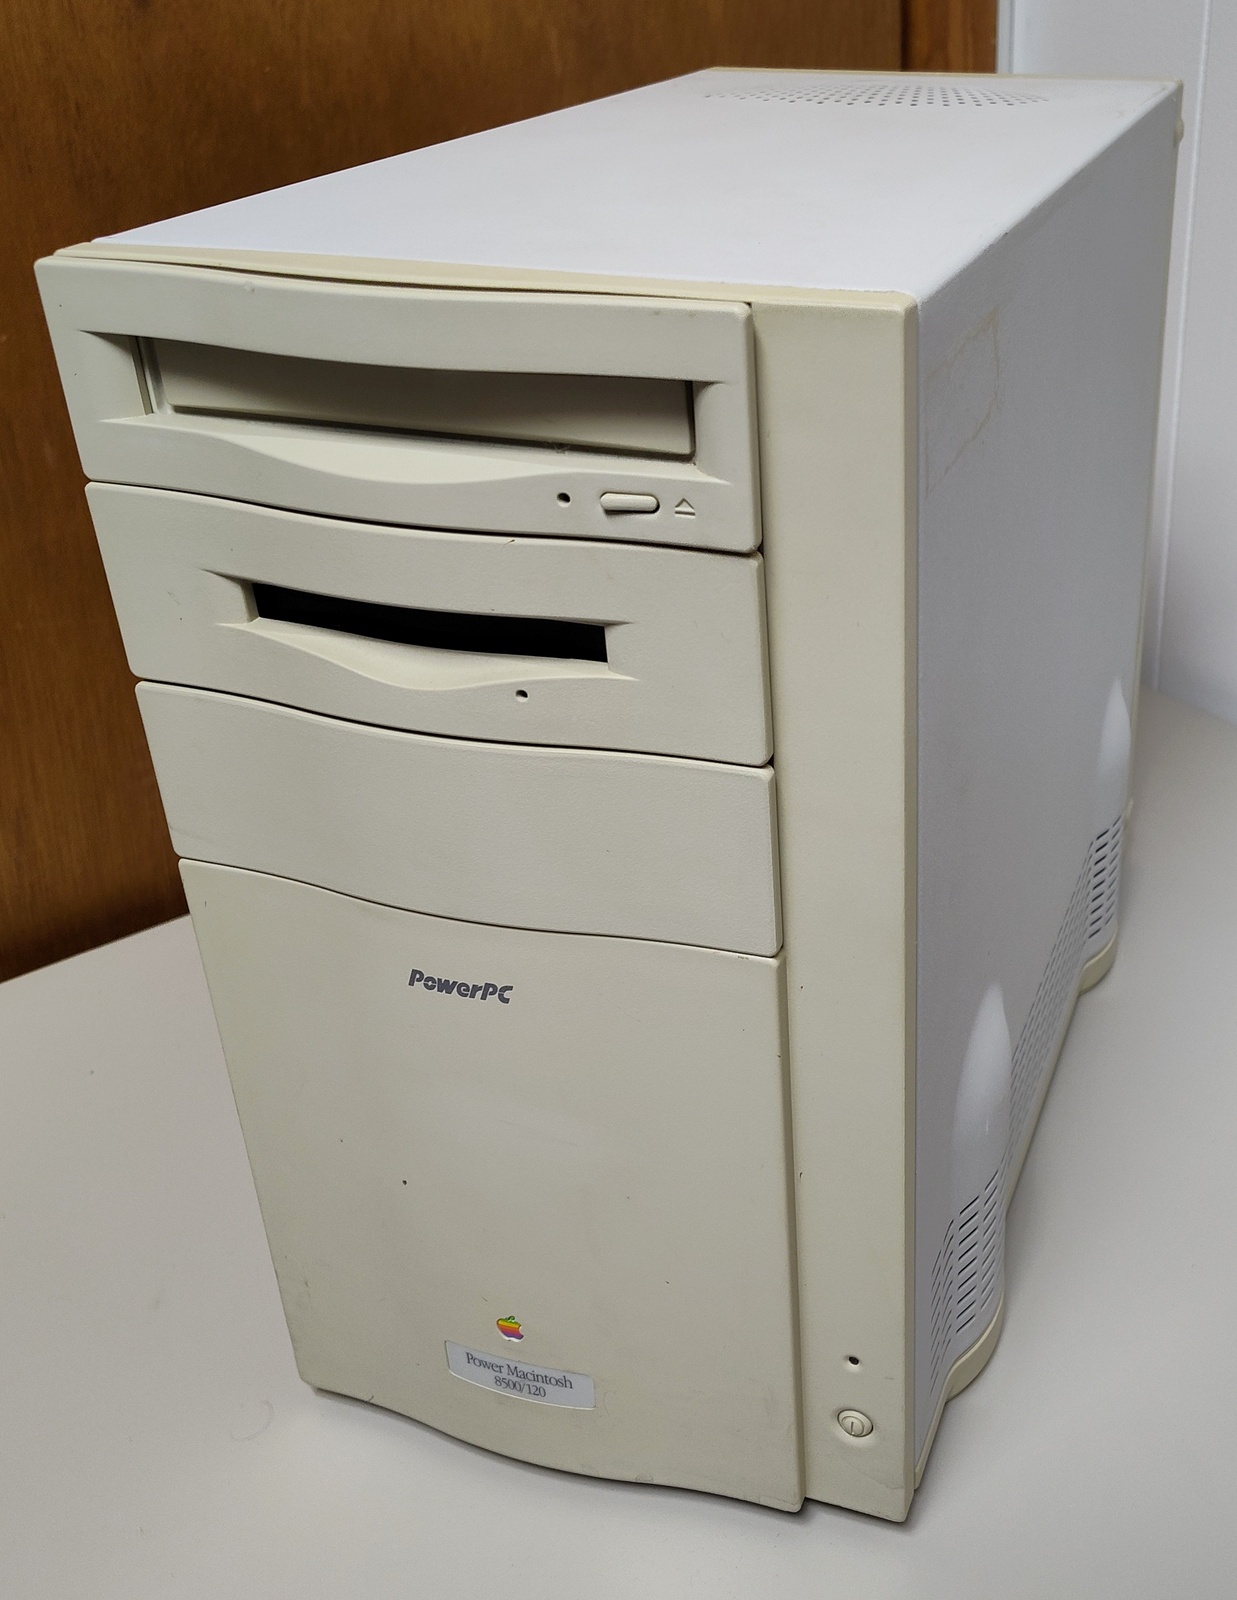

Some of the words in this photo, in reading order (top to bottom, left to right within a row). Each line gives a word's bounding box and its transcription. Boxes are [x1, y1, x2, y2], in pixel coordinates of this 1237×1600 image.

[408, 968, 514, 1004] PowerPC
[465, 1351, 504, 1374] Power
[506, 1363, 574, 1389] Macintosh
[494, 1375, 547, 1398] 8500/120
